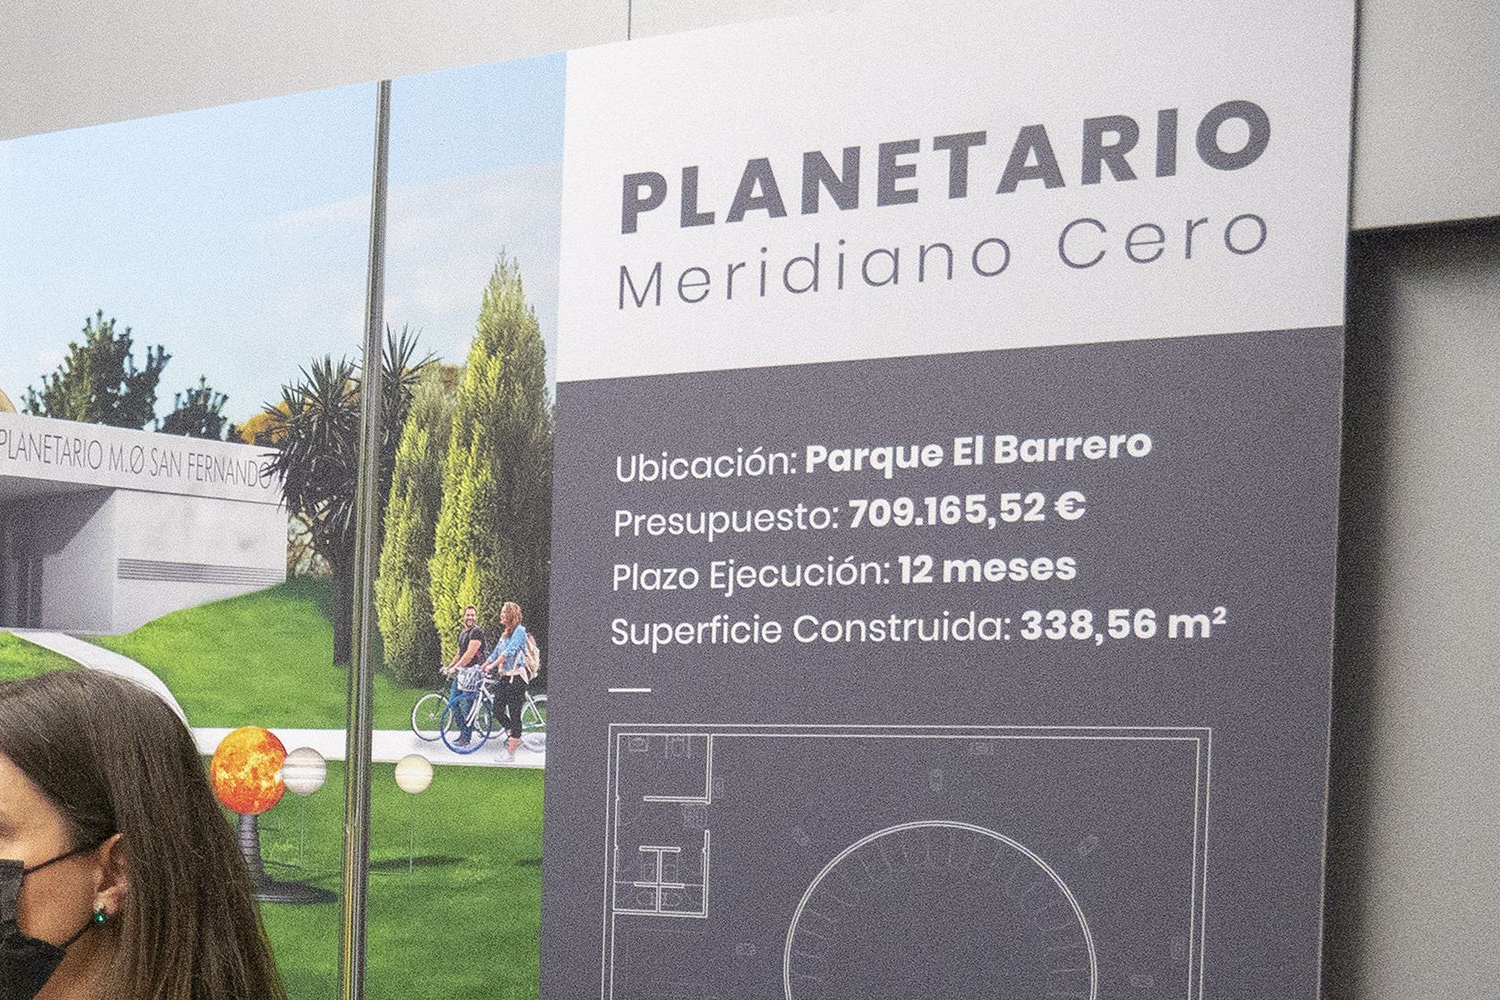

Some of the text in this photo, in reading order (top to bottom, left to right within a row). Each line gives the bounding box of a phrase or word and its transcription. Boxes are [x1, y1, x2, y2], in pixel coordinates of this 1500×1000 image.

[619, 98, 1272, 234] PLANETARIO
[617, 213, 1270, 311] Meridiano Cero
[150, 447, 182, 477] SAN
[188, 452, 271, 489] FERNANDO
[616, 433, 1152, 482] Ubicación: Parque El Barrero
[615, 491, 1086, 542] Presupuesto: 709.165,52 €
[613, 555, 1076, 597] Plazo Ejecución: 12 meses
[611, 606, 1226, 653] Superficie Construida: 338,56 m²
